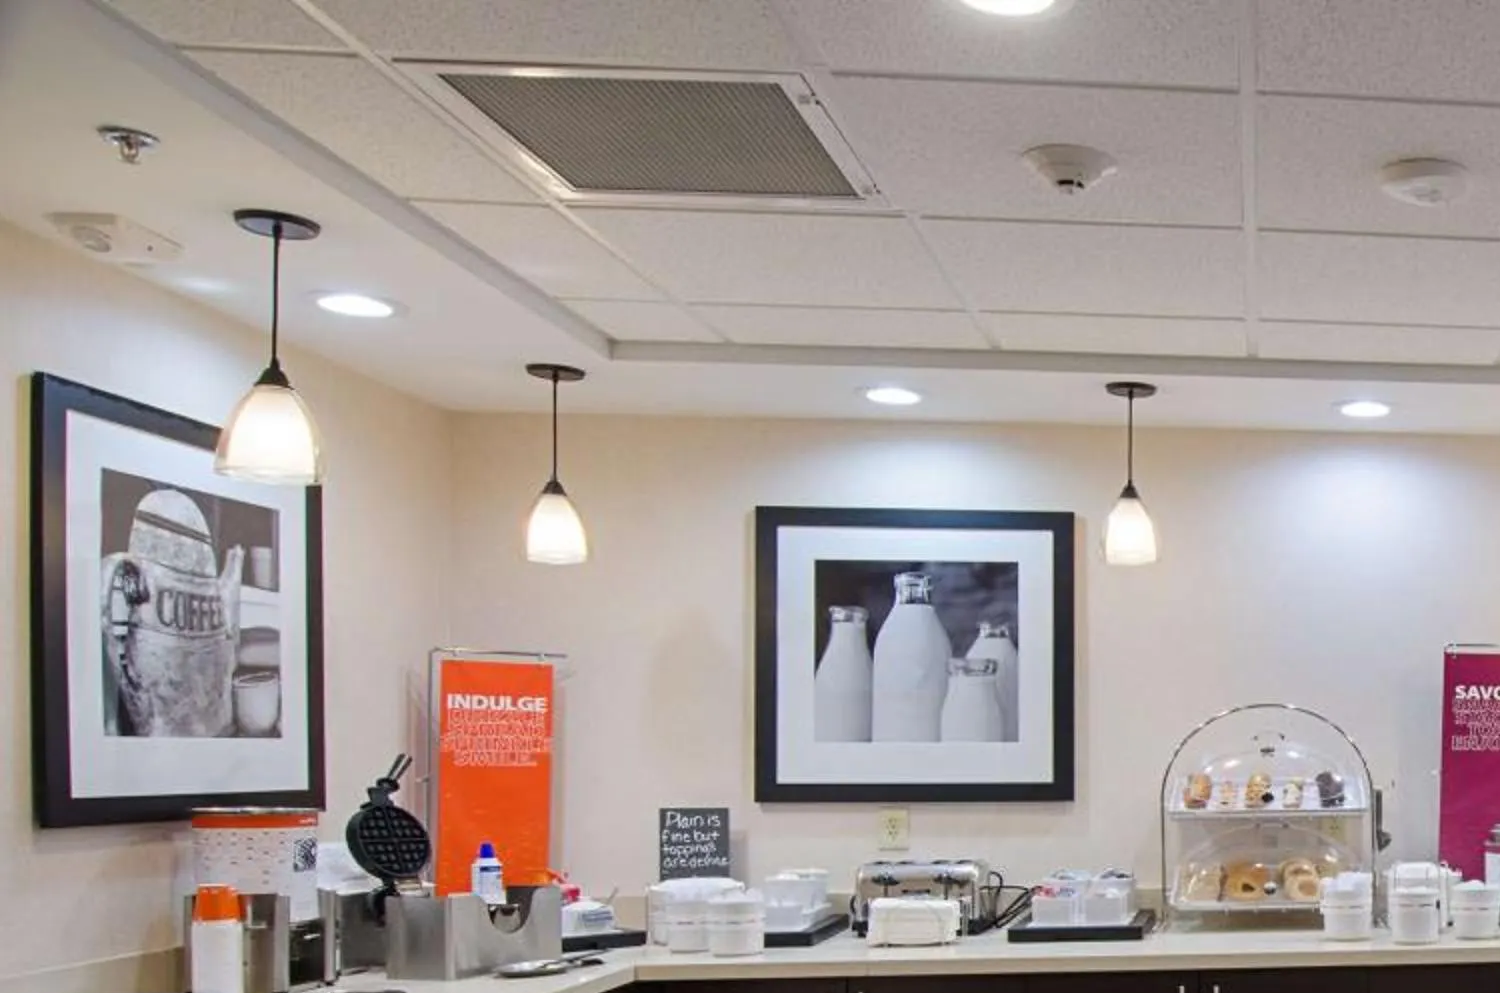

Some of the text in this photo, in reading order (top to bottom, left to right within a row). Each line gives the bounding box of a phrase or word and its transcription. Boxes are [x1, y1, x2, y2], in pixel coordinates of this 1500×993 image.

[156, 588, 224, 632] COFFEE
[447, 693, 548, 713] INDULGE
[665, 811, 721, 829] Plain is
[661, 829, 721, 843] fine but
